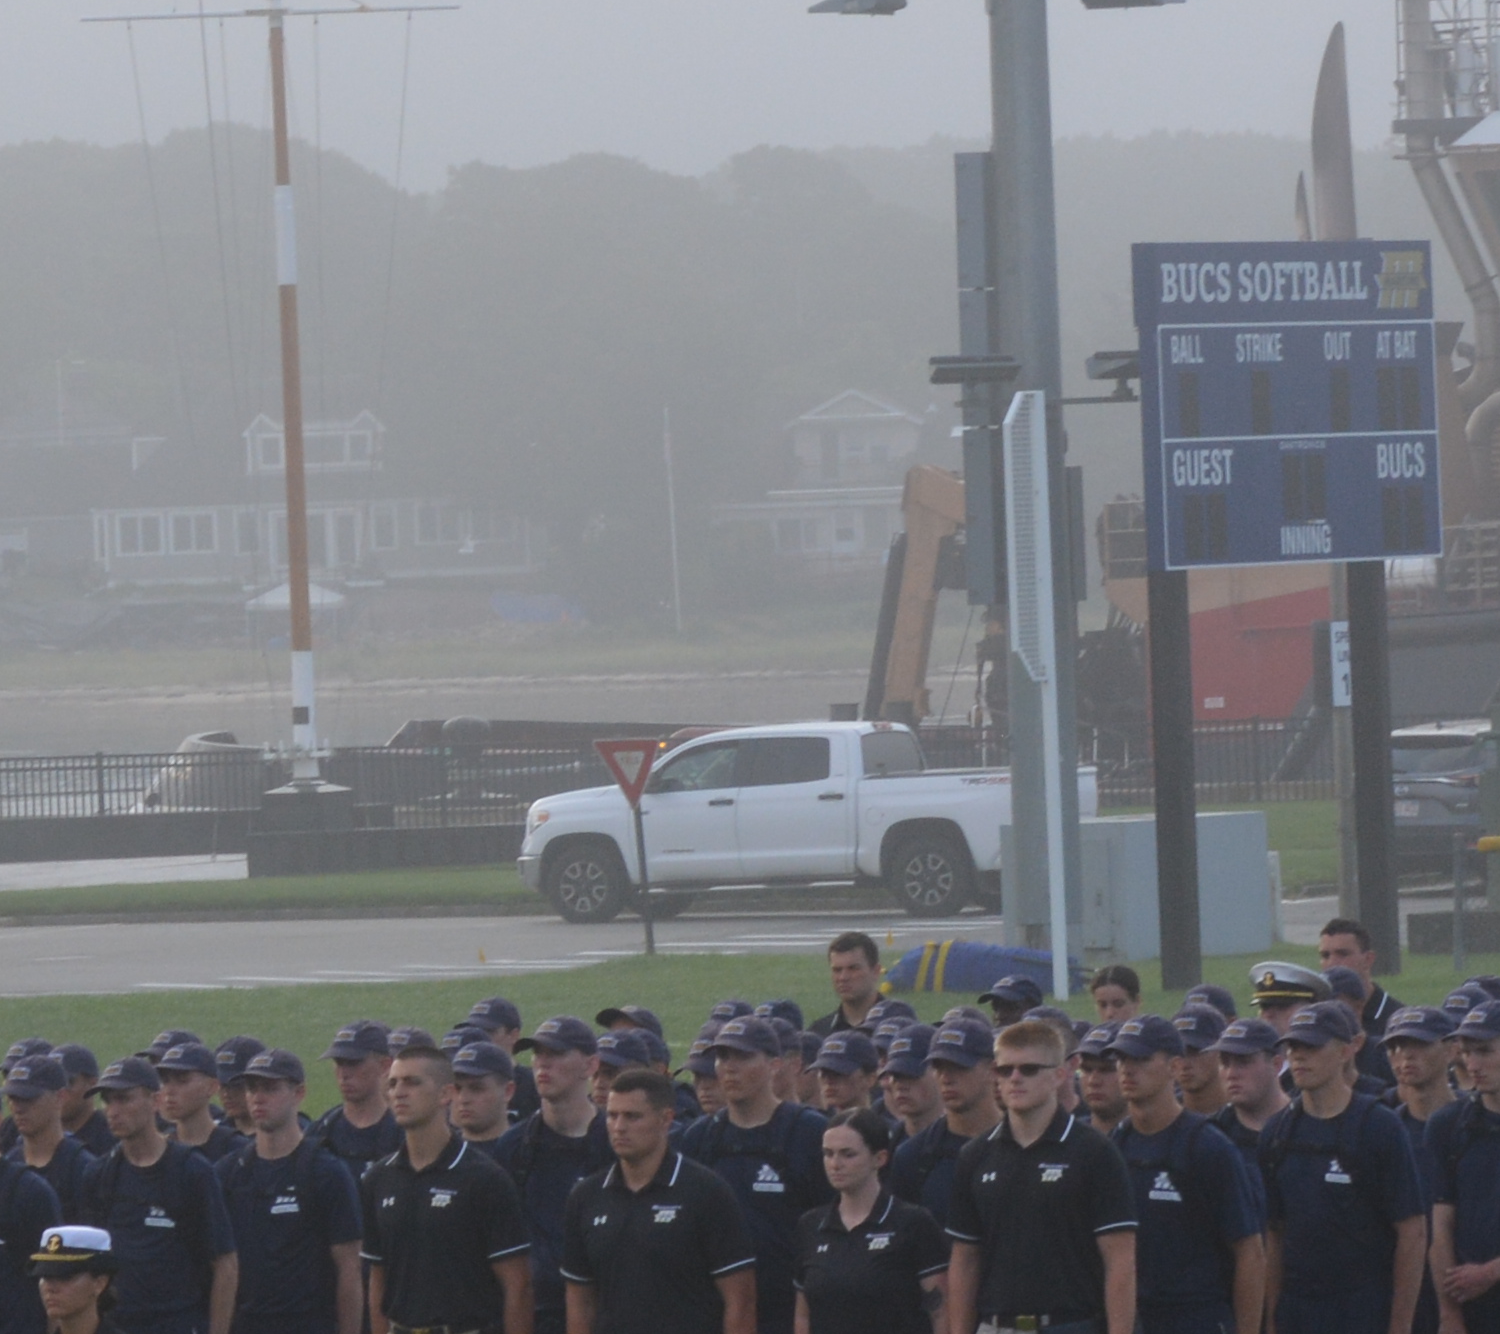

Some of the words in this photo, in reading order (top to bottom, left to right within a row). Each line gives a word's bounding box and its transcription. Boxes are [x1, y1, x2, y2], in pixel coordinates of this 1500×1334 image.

[1160, 262, 1232, 304] BUCS
[1238, 260, 1368, 302] SOFTBALL
[1171, 335, 1204, 364] BALL
[1235, 333, 1283, 363] STRIKE
[1323, 331, 1352, 361] OUT
[1376, 331, 1394, 359] AT
[1394, 330, 1417, 359] BAT
[1172, 448, 1233, 486] GUEST
[1376, 442, 1425, 479] BUCS
[1280, 524, 1332, 555] INNING
